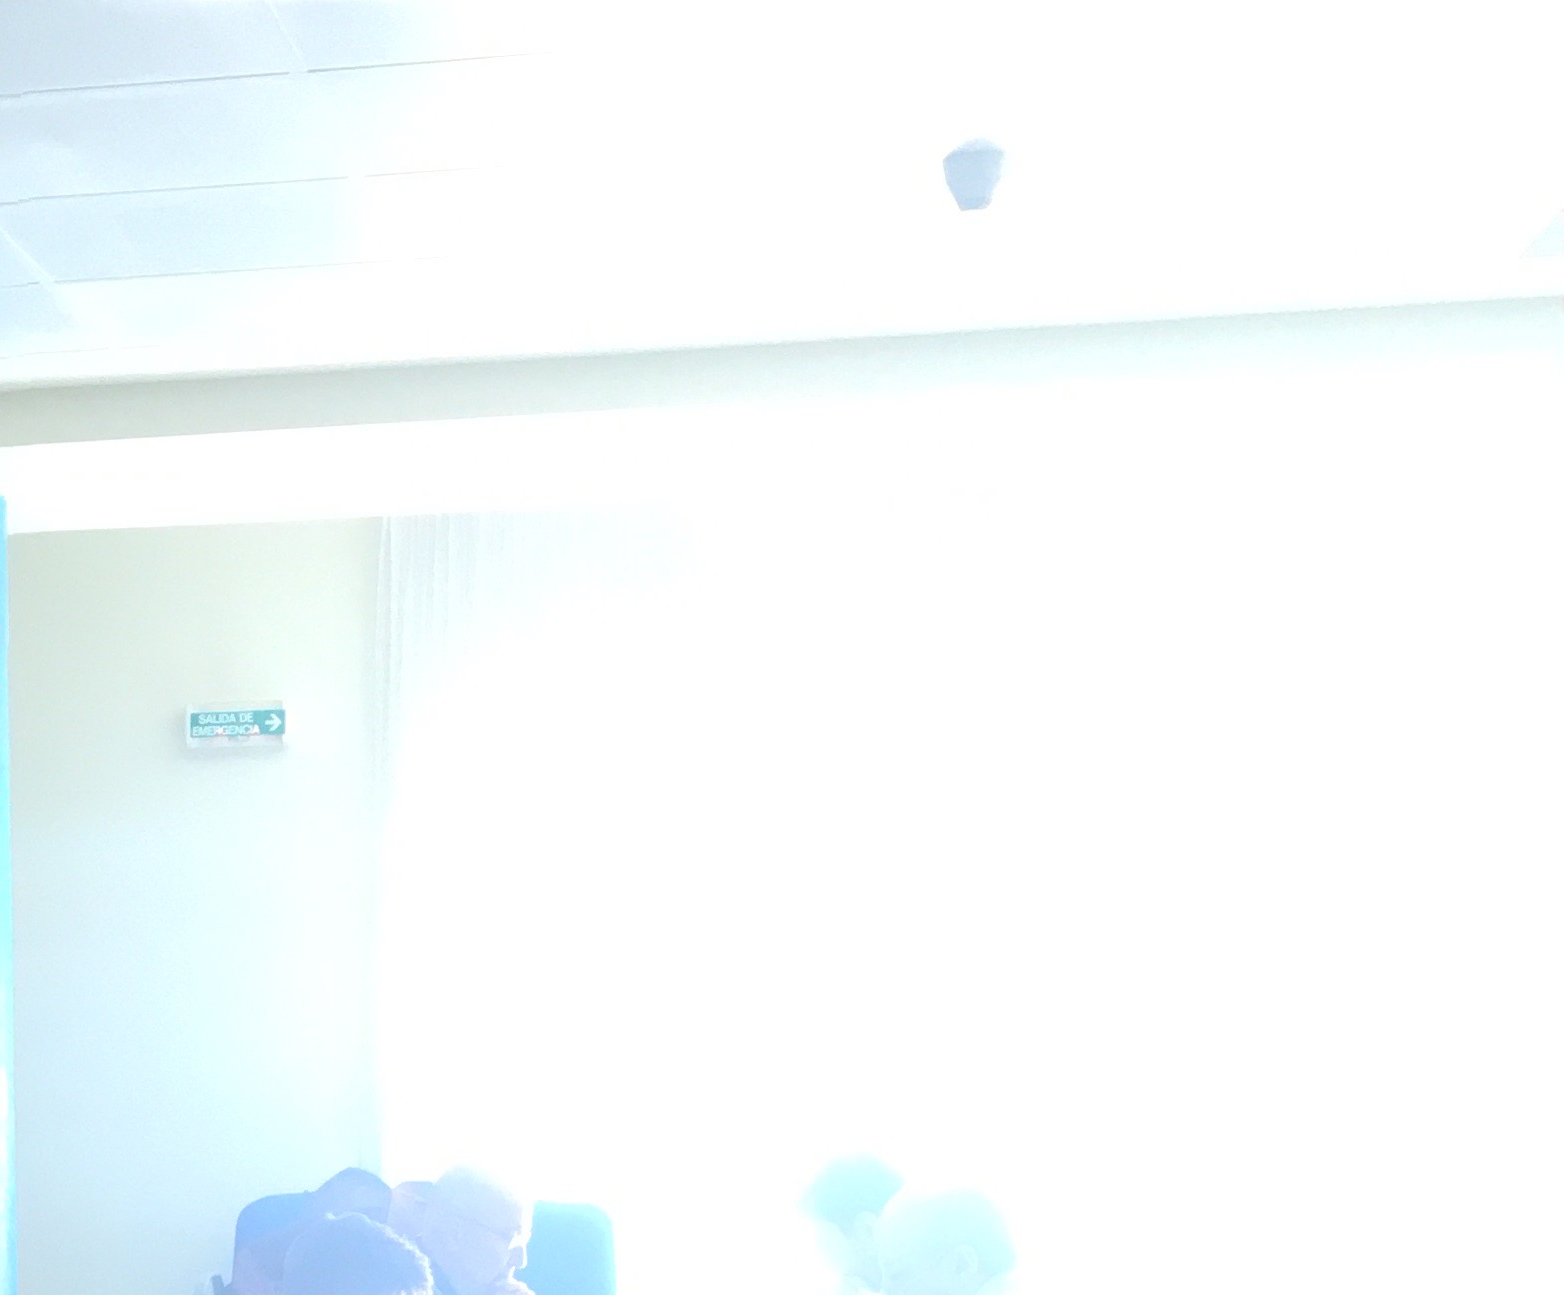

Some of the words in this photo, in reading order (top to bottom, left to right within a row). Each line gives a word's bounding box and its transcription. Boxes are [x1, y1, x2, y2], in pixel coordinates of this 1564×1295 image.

[198, 714, 236, 724] SALIDA
[240, 713, 253, 722] DE
[193, 725, 260, 736] EMERGENCIA
